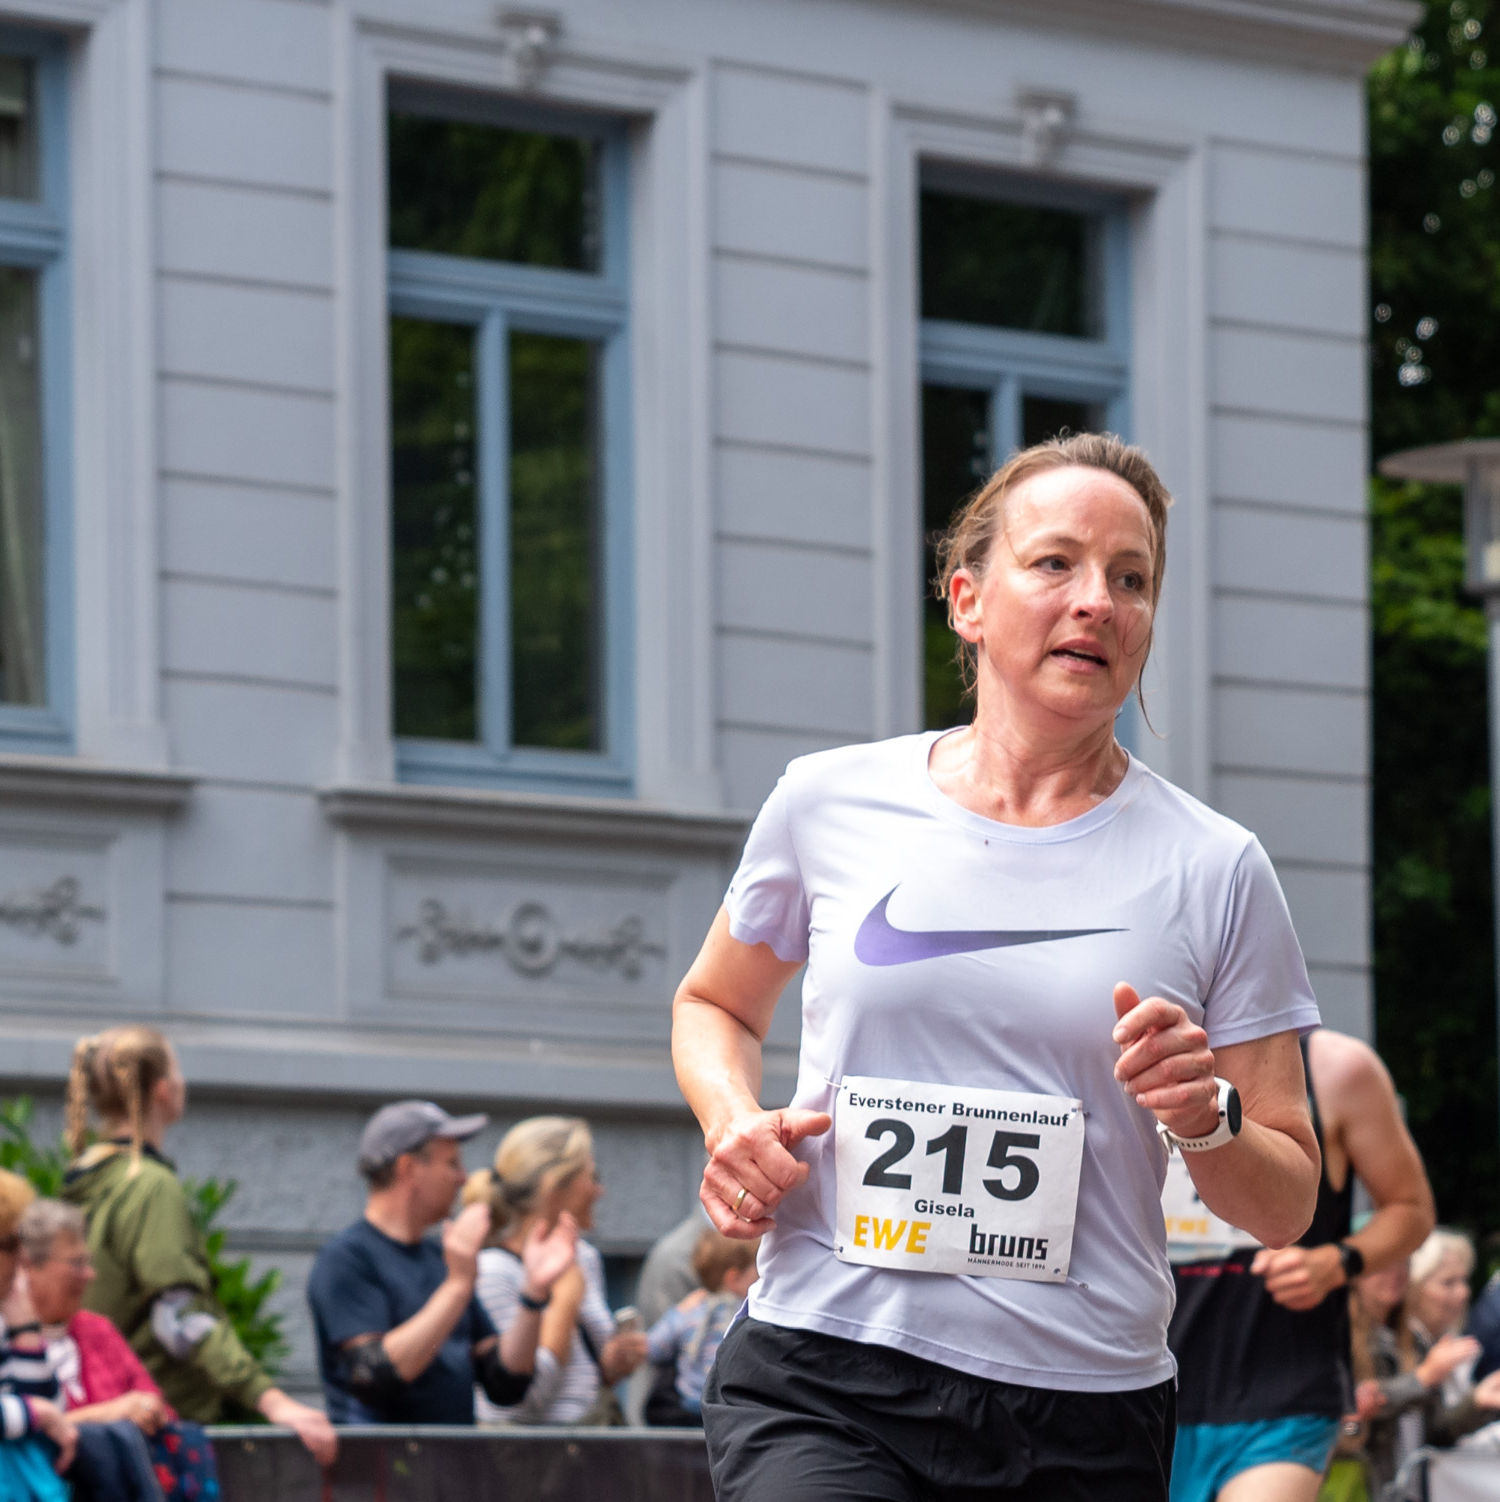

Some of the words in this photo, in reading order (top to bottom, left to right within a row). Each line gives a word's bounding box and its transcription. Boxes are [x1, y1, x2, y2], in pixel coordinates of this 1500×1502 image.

[849, 1093, 947, 1114] Everstener
[952, 1103, 1070, 1127] Brunnenlauf
[862, 1118, 1041, 1202] 215
[914, 1199, 976, 1218] Gisela
[853, 1214, 932, 1254] EWE
[968, 1223, 1049, 1260] bruns
[1016, 1261, 1030, 1269] SEIT
